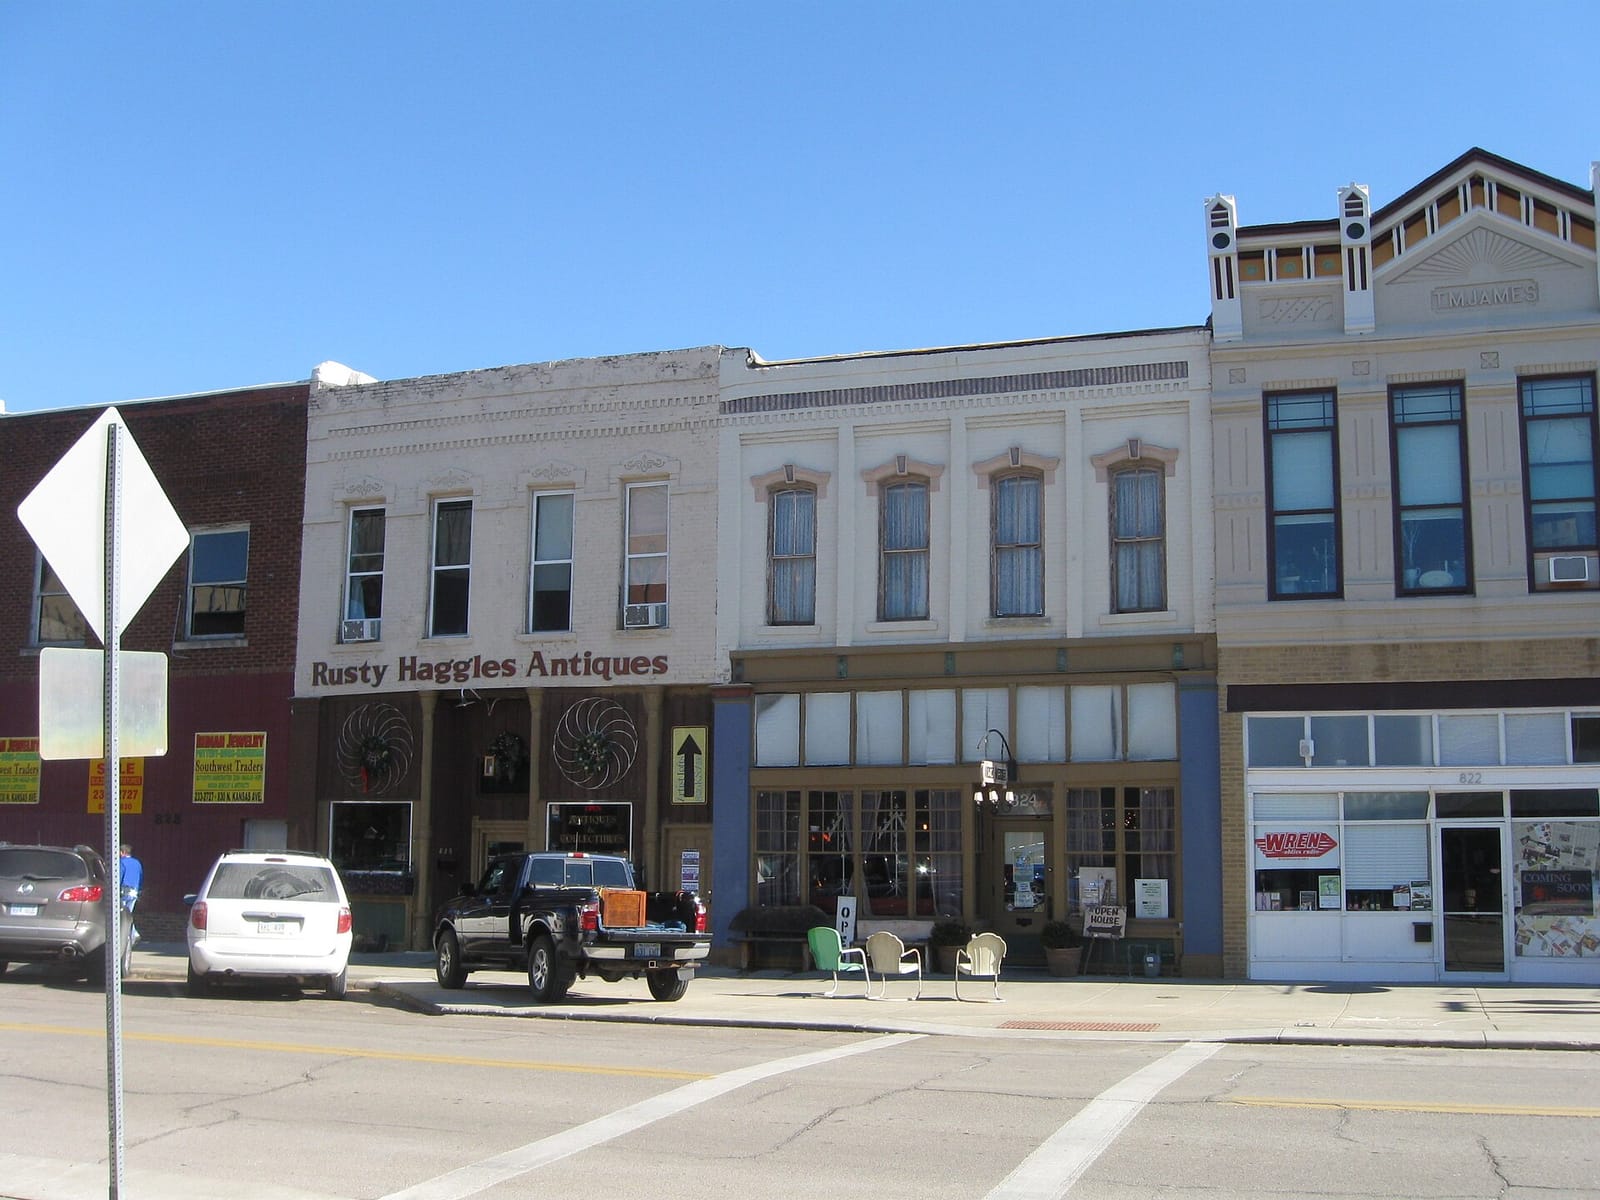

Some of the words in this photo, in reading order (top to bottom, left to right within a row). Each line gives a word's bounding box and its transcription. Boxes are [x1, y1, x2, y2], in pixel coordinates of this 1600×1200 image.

[312, 660, 389, 688] Rusty
[398, 654, 517, 685] Haggles
[526, 650, 669, 681] Antiques
[14, 763, 39, 775] Traders
[195, 760, 233, 772] Southwest
[234, 760, 264, 772] Traders
[1459, 773, 1482, 784] 822
[1265, 832, 1321, 852] WREN
[1523, 873, 1571, 883] COMING
[1557, 883, 1592, 893] SOON
[1094, 907, 1119, 916] OPEN
[1090, 915, 1120, 926] HOUSE
